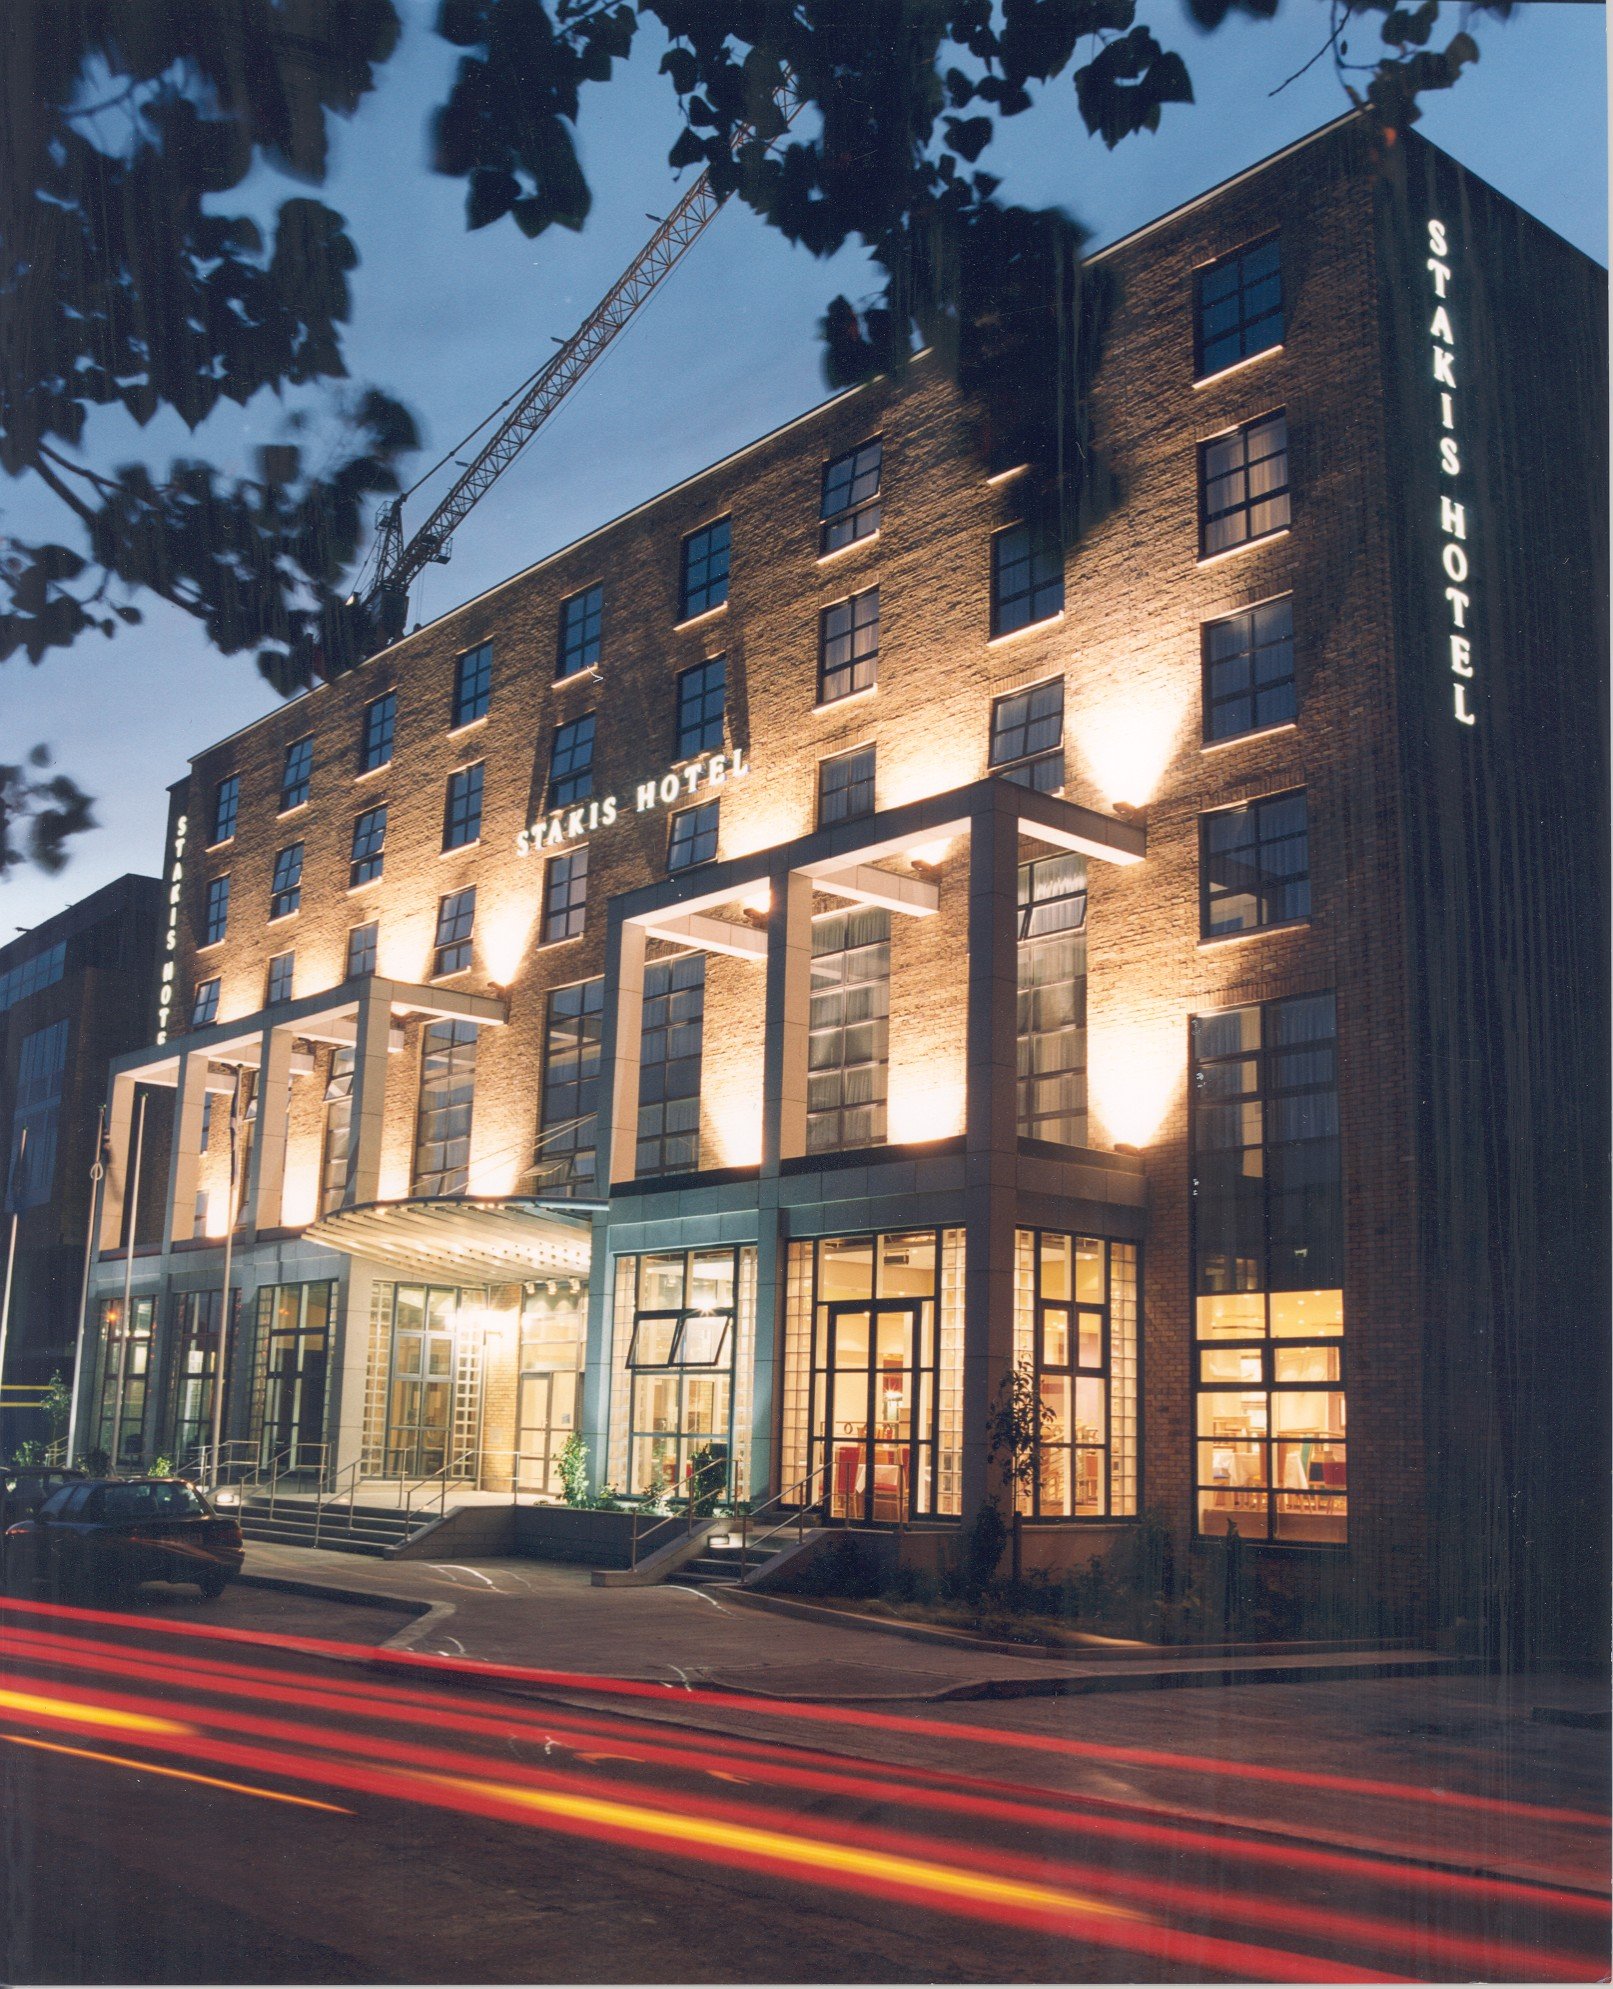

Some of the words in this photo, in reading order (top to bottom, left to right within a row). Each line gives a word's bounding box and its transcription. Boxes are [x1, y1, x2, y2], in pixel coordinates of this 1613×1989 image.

[1427, 219, 1460, 476] STAKIS
[1440, 495, 1476, 726] HOTEL
[516, 796, 617, 857] STAKIS
[636, 748, 749, 813] HOTEL
[166, 815, 187, 950] STAKIS
[157, 961, 174, 1046] HOTE
